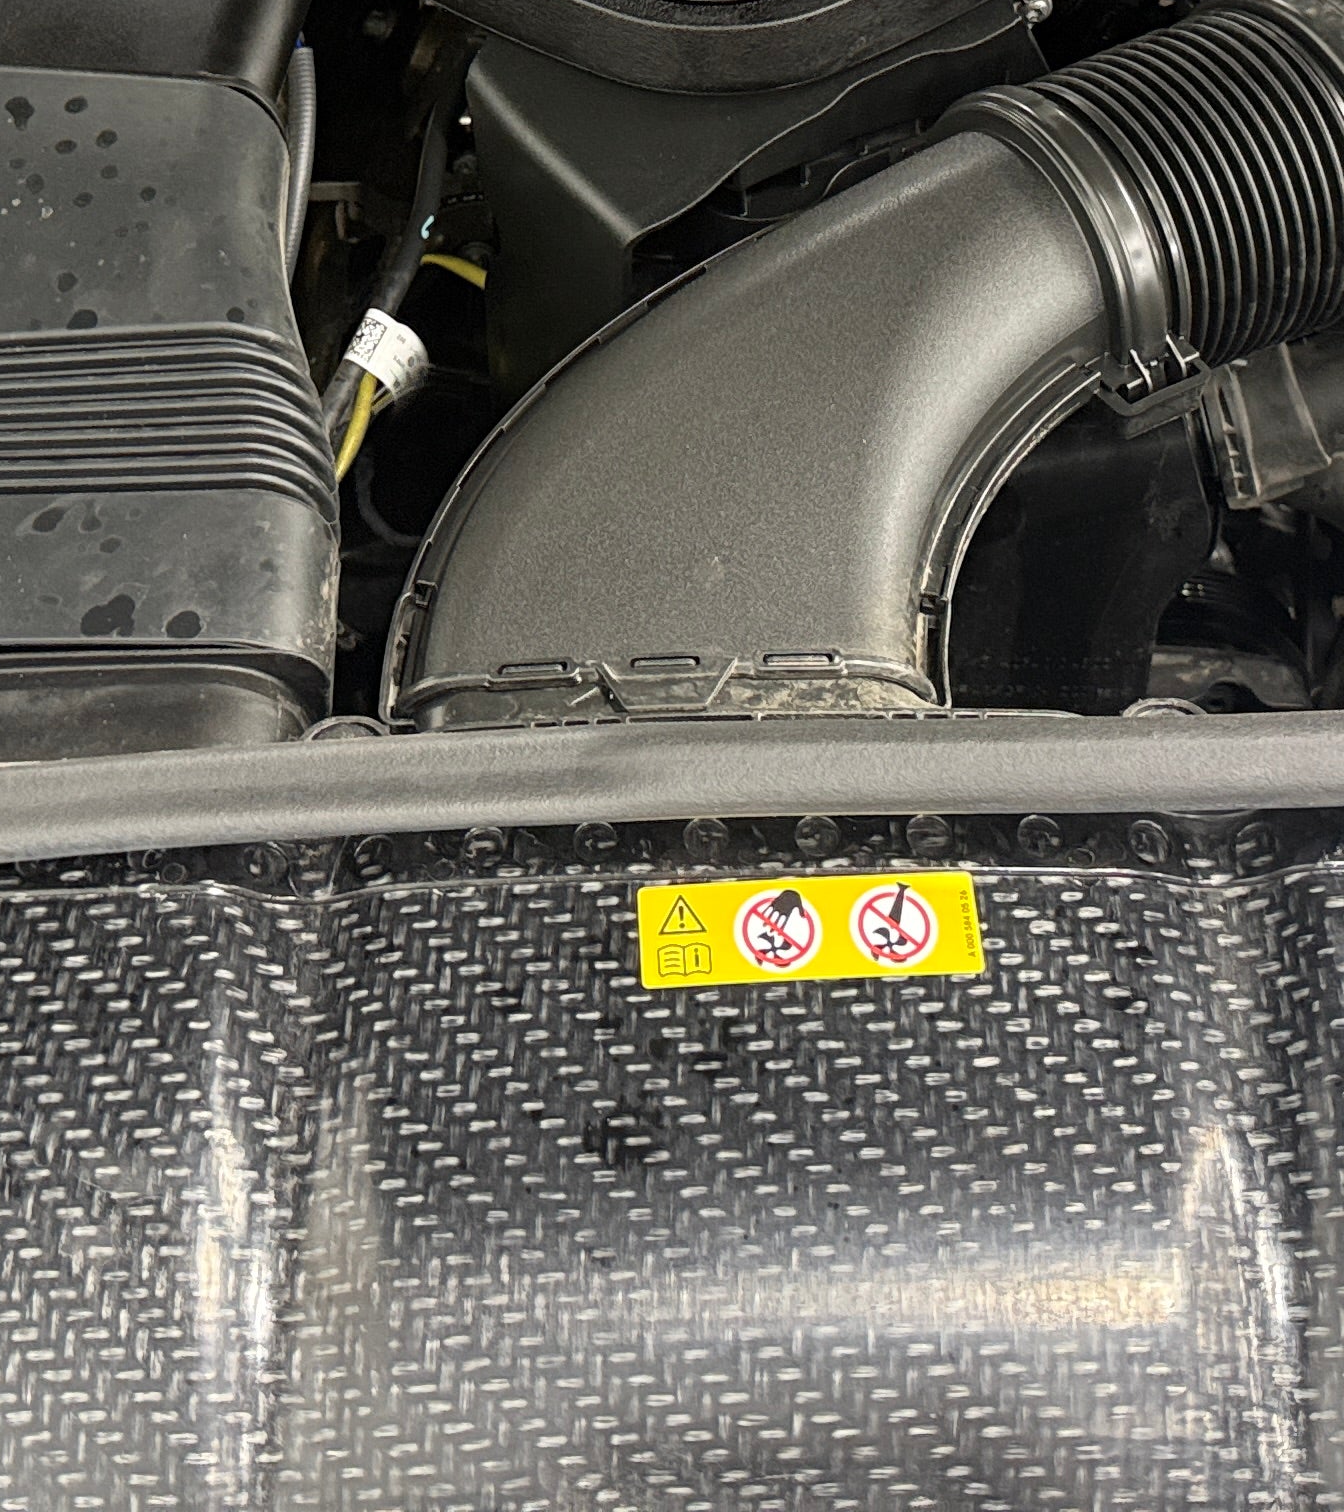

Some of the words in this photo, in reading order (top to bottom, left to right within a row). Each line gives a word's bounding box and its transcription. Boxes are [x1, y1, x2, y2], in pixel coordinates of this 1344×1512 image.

[959, 889, 968, 901] 26
[961, 902, 970, 913] 05
[963, 915, 972, 931] 584
[965, 933, 975, 949] 000
